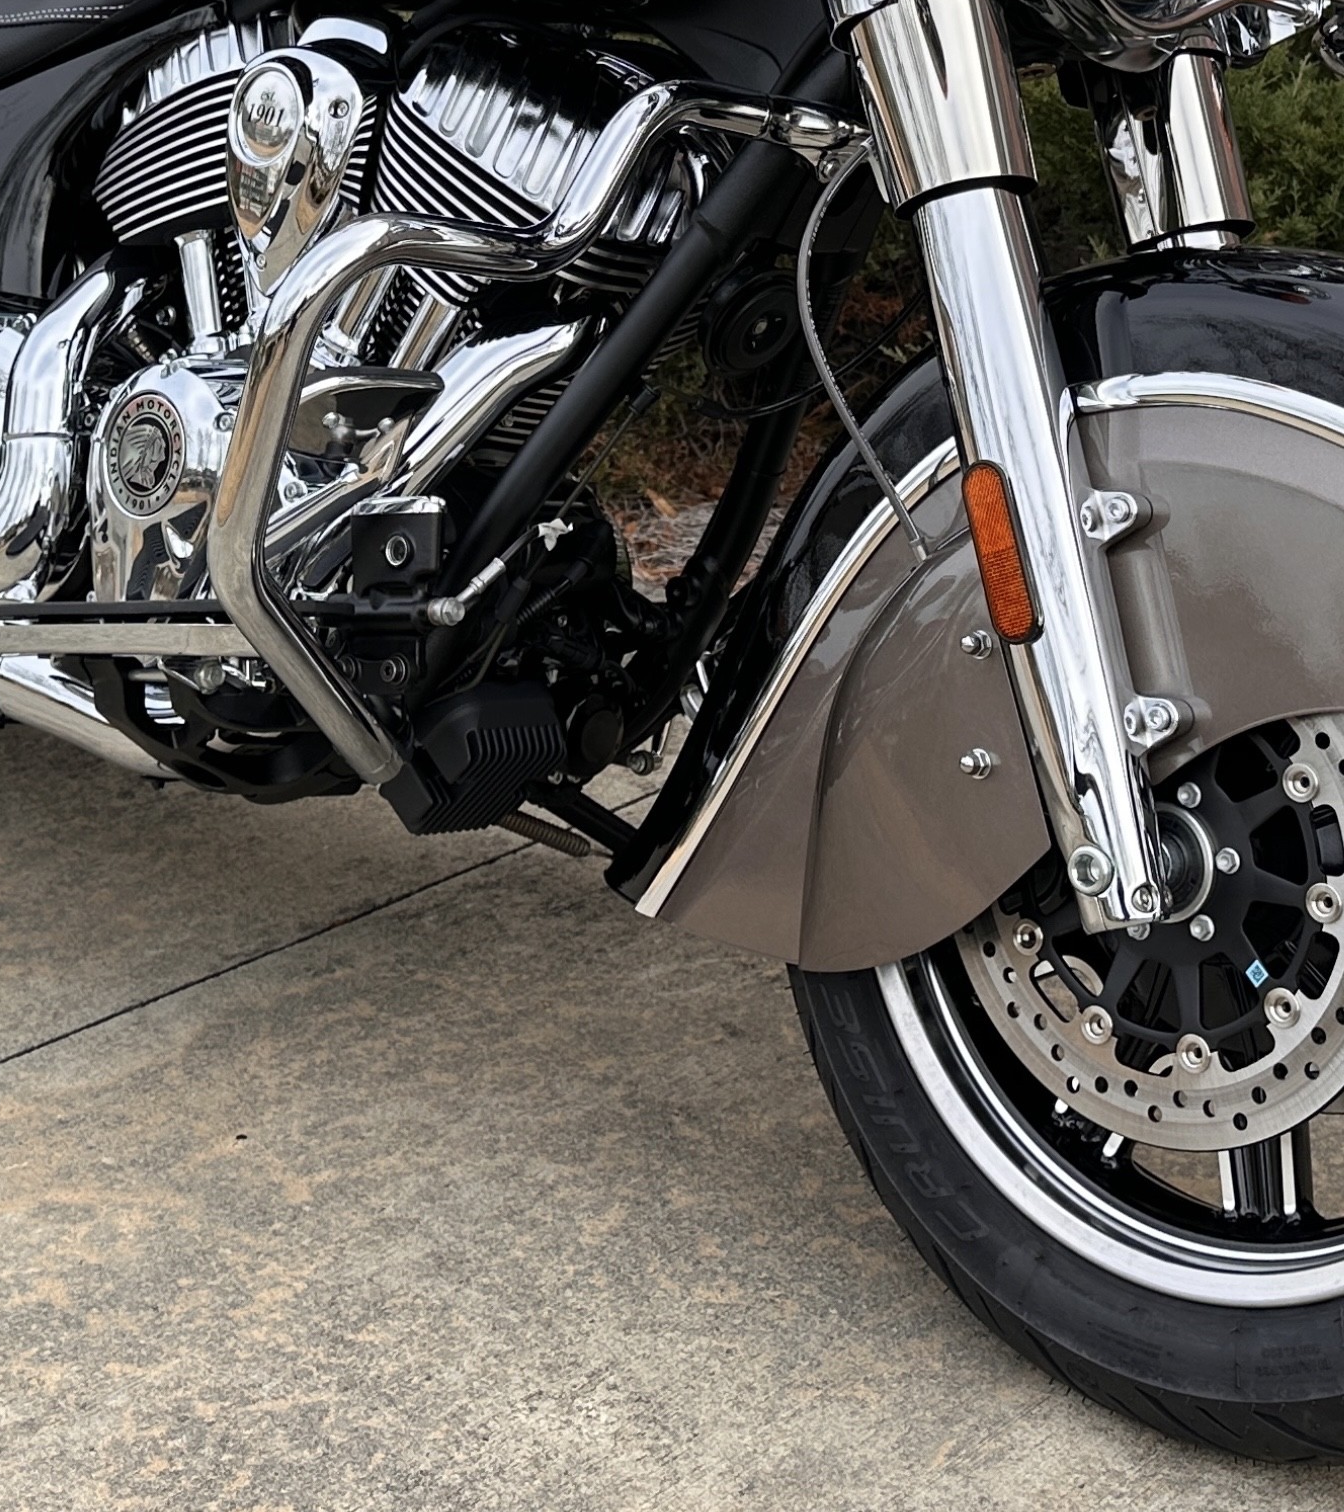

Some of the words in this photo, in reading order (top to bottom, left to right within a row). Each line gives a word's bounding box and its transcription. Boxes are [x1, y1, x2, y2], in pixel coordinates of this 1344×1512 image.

[247, 104, 285, 128] 1901
[110, 412, 132, 483] INDIAN
[136, 399, 181, 494] MOTORCYCLE
